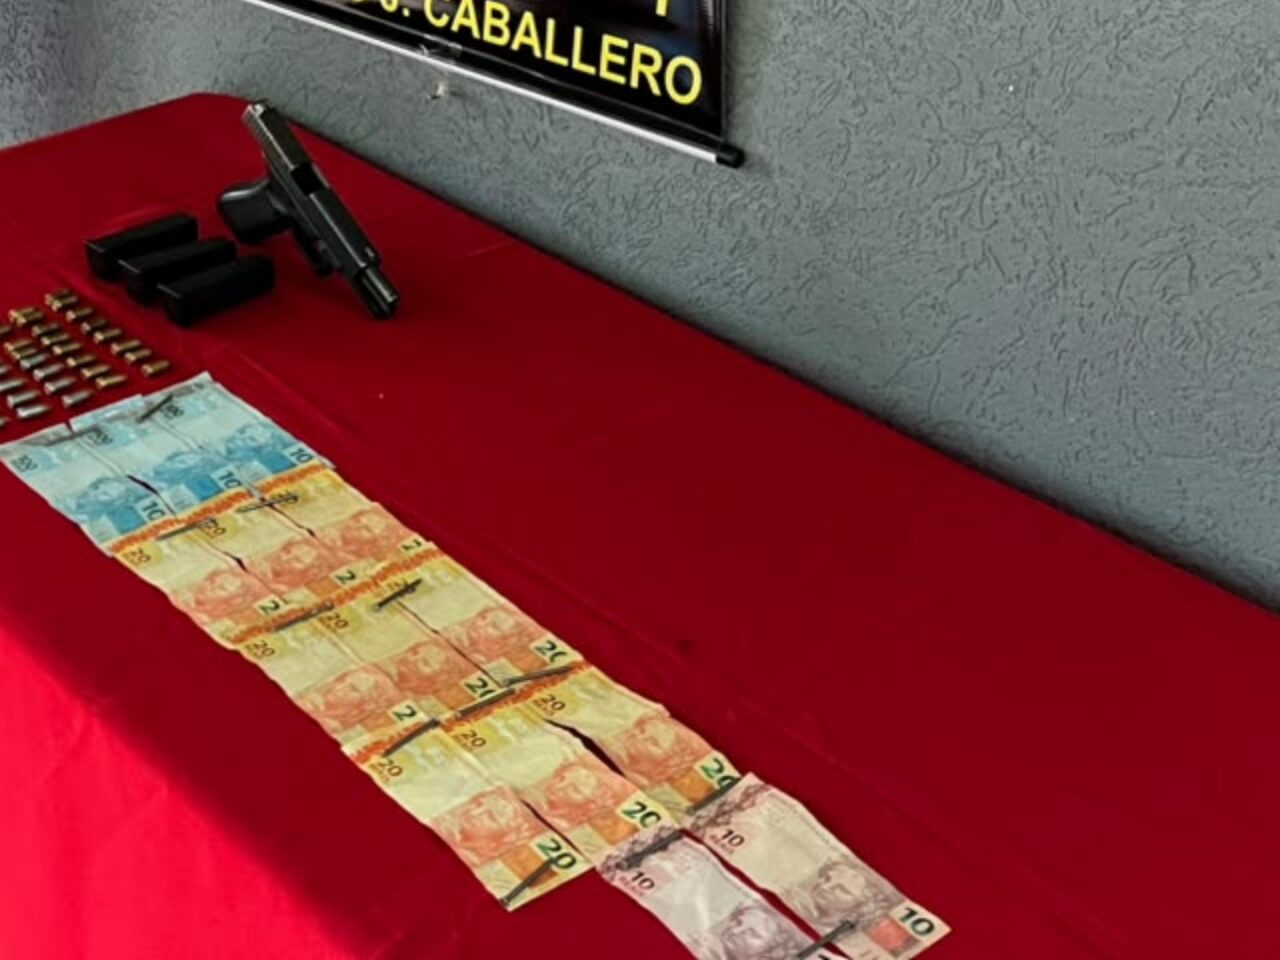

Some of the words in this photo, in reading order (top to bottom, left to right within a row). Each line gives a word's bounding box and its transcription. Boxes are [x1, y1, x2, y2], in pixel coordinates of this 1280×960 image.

[540, 693, 566, 712] 20
[460, 729, 487, 749] 20
[376, 758, 404, 778] 20
[720, 828, 746, 848] 10
[536, 836, 578, 872] 20
[631, 871, 656, 892] 10
[898, 906, 936, 937] 10
